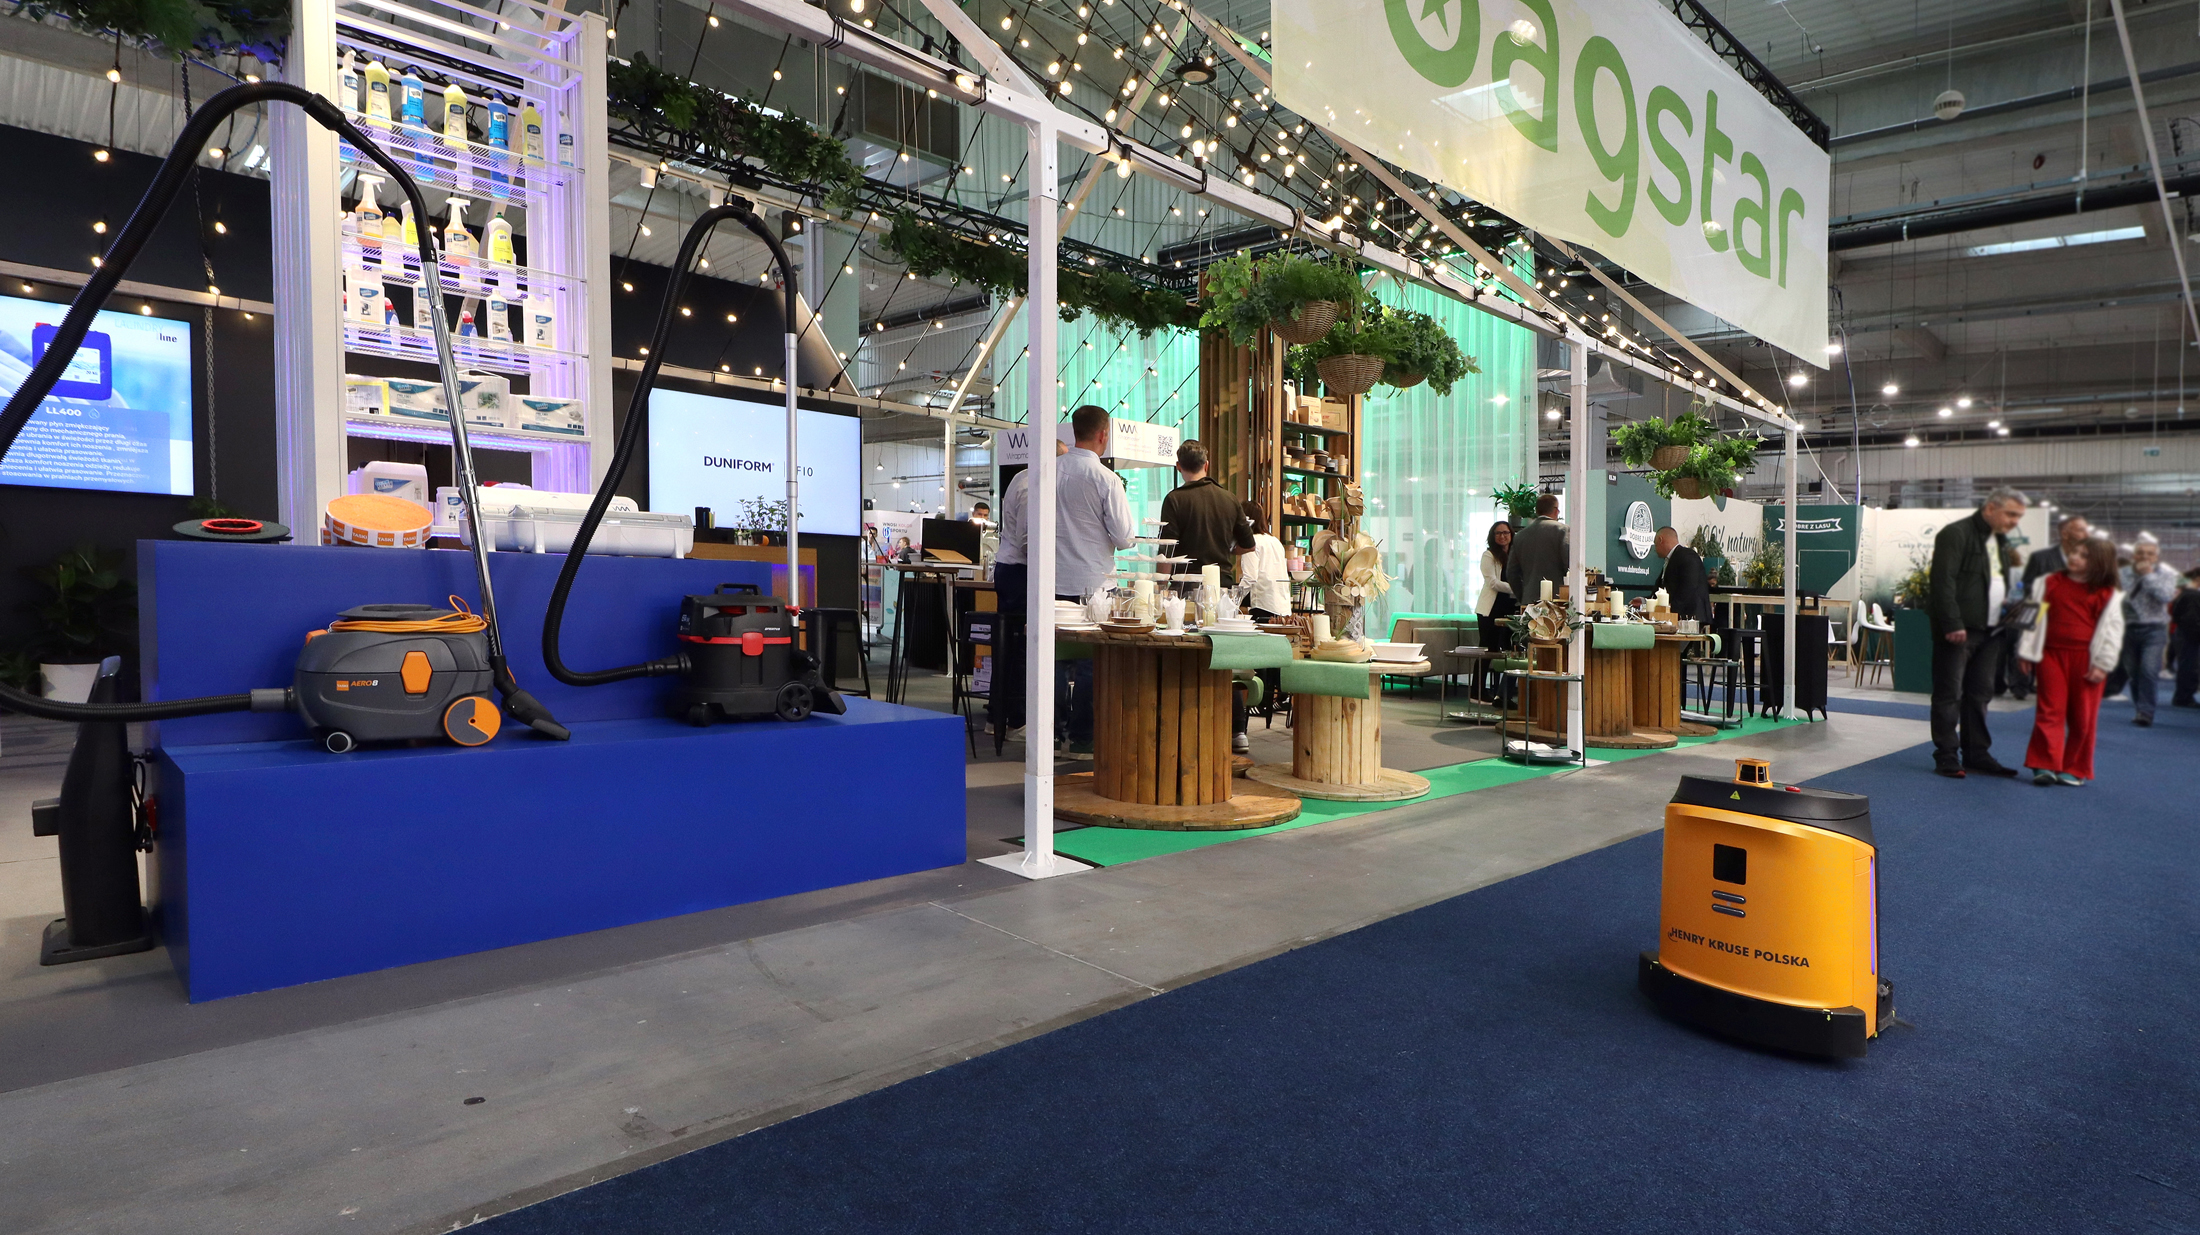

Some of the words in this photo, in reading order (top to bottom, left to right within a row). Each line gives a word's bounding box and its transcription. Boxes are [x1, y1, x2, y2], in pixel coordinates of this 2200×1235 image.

[46, 406, 82, 416] LL400
[1670, 927, 1705, 946] HENRY
[1708, 938, 1750, 957] KRUSE
[1754, 949, 1810, 968] POLSKA
